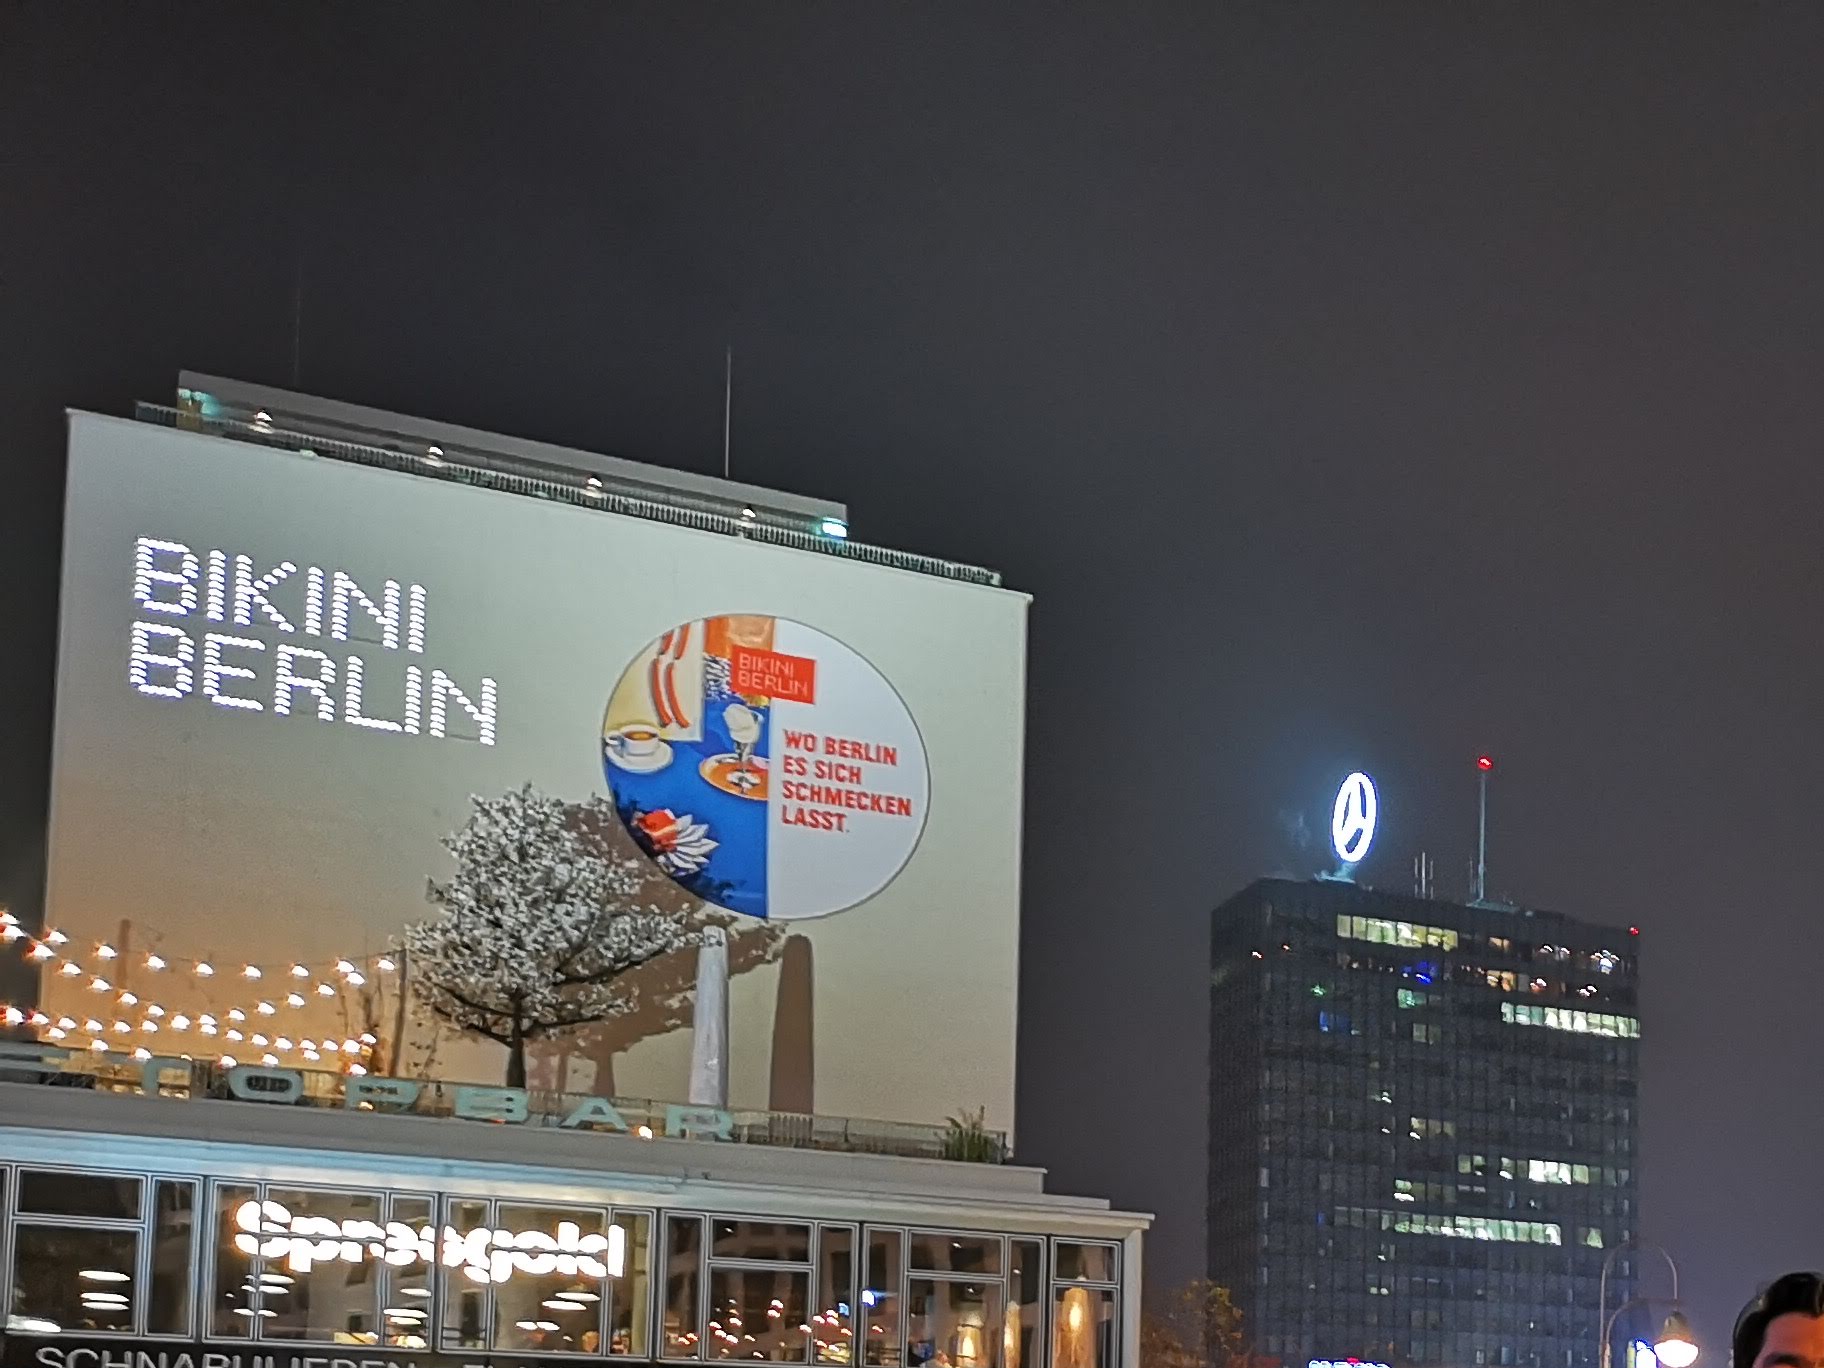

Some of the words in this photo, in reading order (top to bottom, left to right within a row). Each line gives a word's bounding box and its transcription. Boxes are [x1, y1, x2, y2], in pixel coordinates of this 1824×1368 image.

[134, 535, 427, 653] BIKINI
[129, 620, 498, 746] BERLIN
[737, 671, 809, 697] BERLIN
[739, 653, 794, 678] BIKINI
[782, 728, 818, 753] WO
[824, 736, 897, 766] BERLIN
[782, 754, 808, 777] ES
[814, 758, 862, 785] SICH
[781, 779, 912, 817] SCHMECKEN
[451, 1085, 735, 1142] BAR
[234, 1199, 626, 1284] Spreegold
